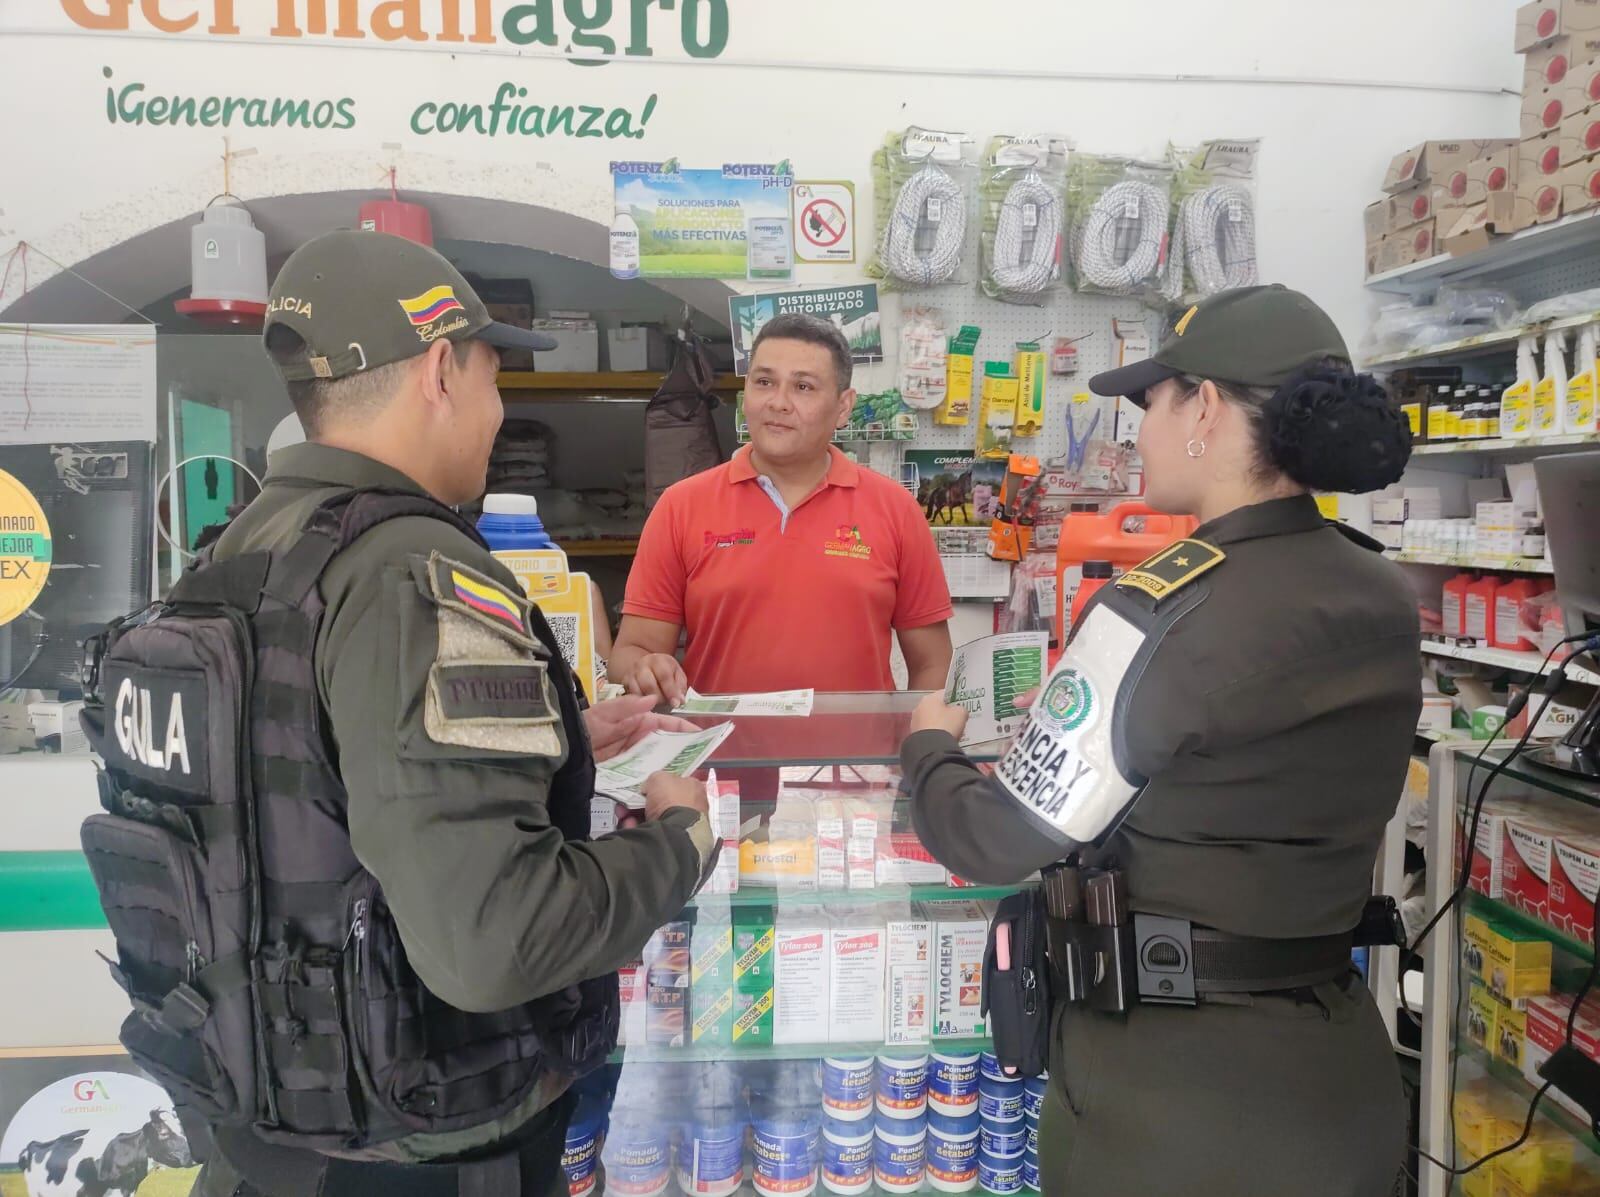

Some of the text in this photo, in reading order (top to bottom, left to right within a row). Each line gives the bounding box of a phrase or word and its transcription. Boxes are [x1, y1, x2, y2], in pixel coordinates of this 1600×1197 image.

[410, 81, 658, 139] confianza!
[762, 177, 792, 190] pH-D
[657, 199, 741, 208] SOLUCIONES PARA
[682, 230, 747, 241] EFECTIVAS
[778, 289, 864, 306] DISTRIBUIDOR
[265, 296, 312, 320] LICIA
[779, 299, 864, 315] AUTORIZADO
[415, 316, 470, 342] Colombia
[0, 537, 34, 553] EJOR
[1067, 759, 1093, 790] Y
[890, 924, 927, 932] TYLOCHEM
[939, 934, 953, 1016] TYLOCHEM
[893, 977, 903, 1028] TYLOCHEM
[895, 1067, 925, 1078] Pomada
[944, 1063, 974, 1073] Pomada
[943, 1141, 973, 1150] Pomada
